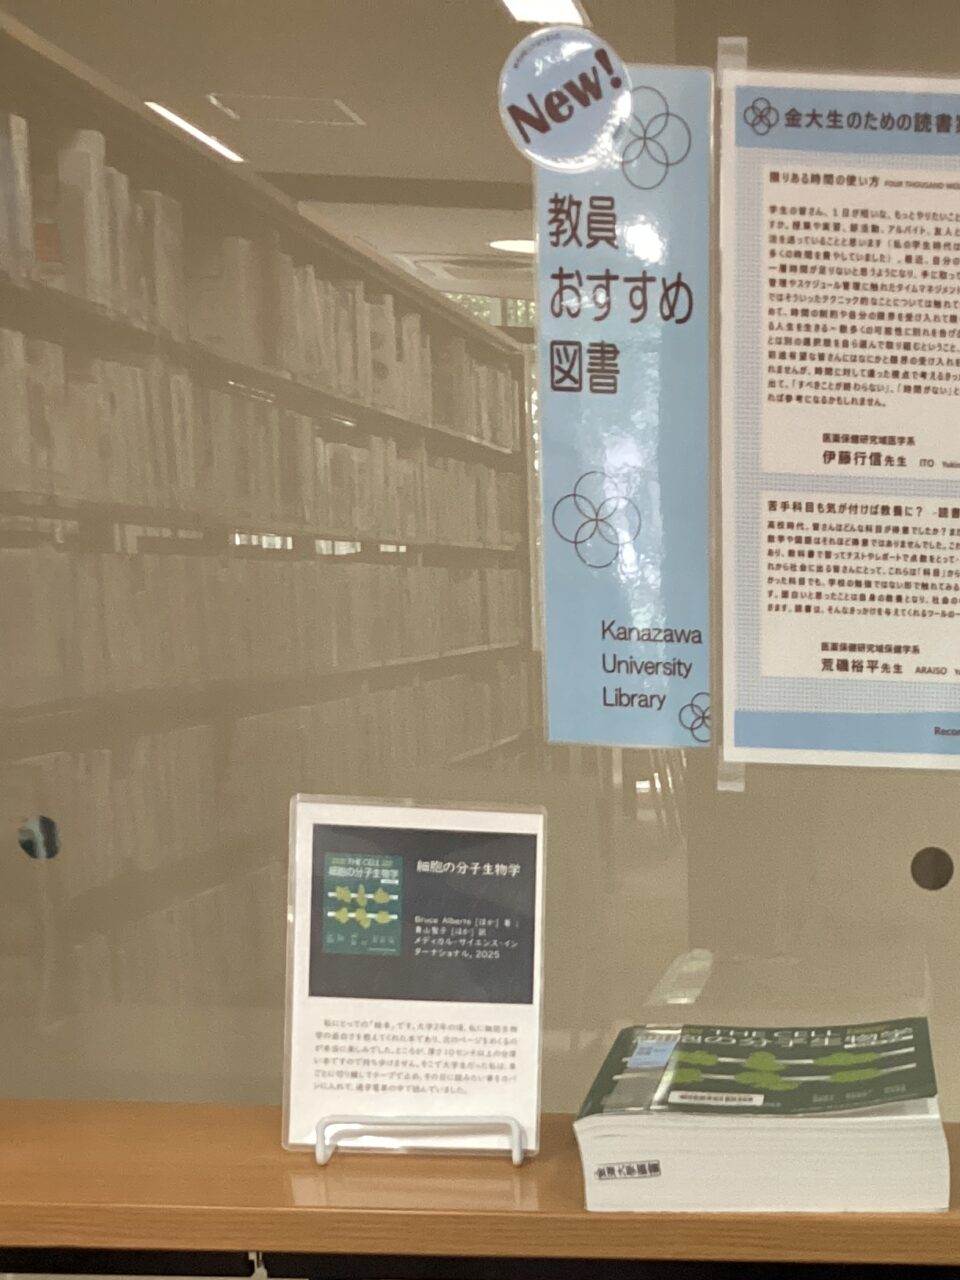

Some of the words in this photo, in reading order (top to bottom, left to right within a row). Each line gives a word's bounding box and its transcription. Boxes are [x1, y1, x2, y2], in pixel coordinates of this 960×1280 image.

[507, 47, 623, 145] New!
[769, 171, 880, 187] 限りある時間の使い方
[547, 192, 619, 250] 教員
[550, 266, 694, 324] おすすめ
[550, 340, 621, 394] 図書
[822, 450, 907, 467] 伊藤行信先生
[919, 459, 935, 468] ITO
[767, 500, 923, 517] 苦手科目も気が付けば教養に？
[601, 619, 703, 644] Kanazawa
[602, 652, 693, 679] University
[821, 657, 903, 674] 荒磯裕平先生
[915, 666, 947, 675] ARAISO
[602, 686, 666, 711] Library
[416, 860, 521, 877] 細胞の分子生物学
